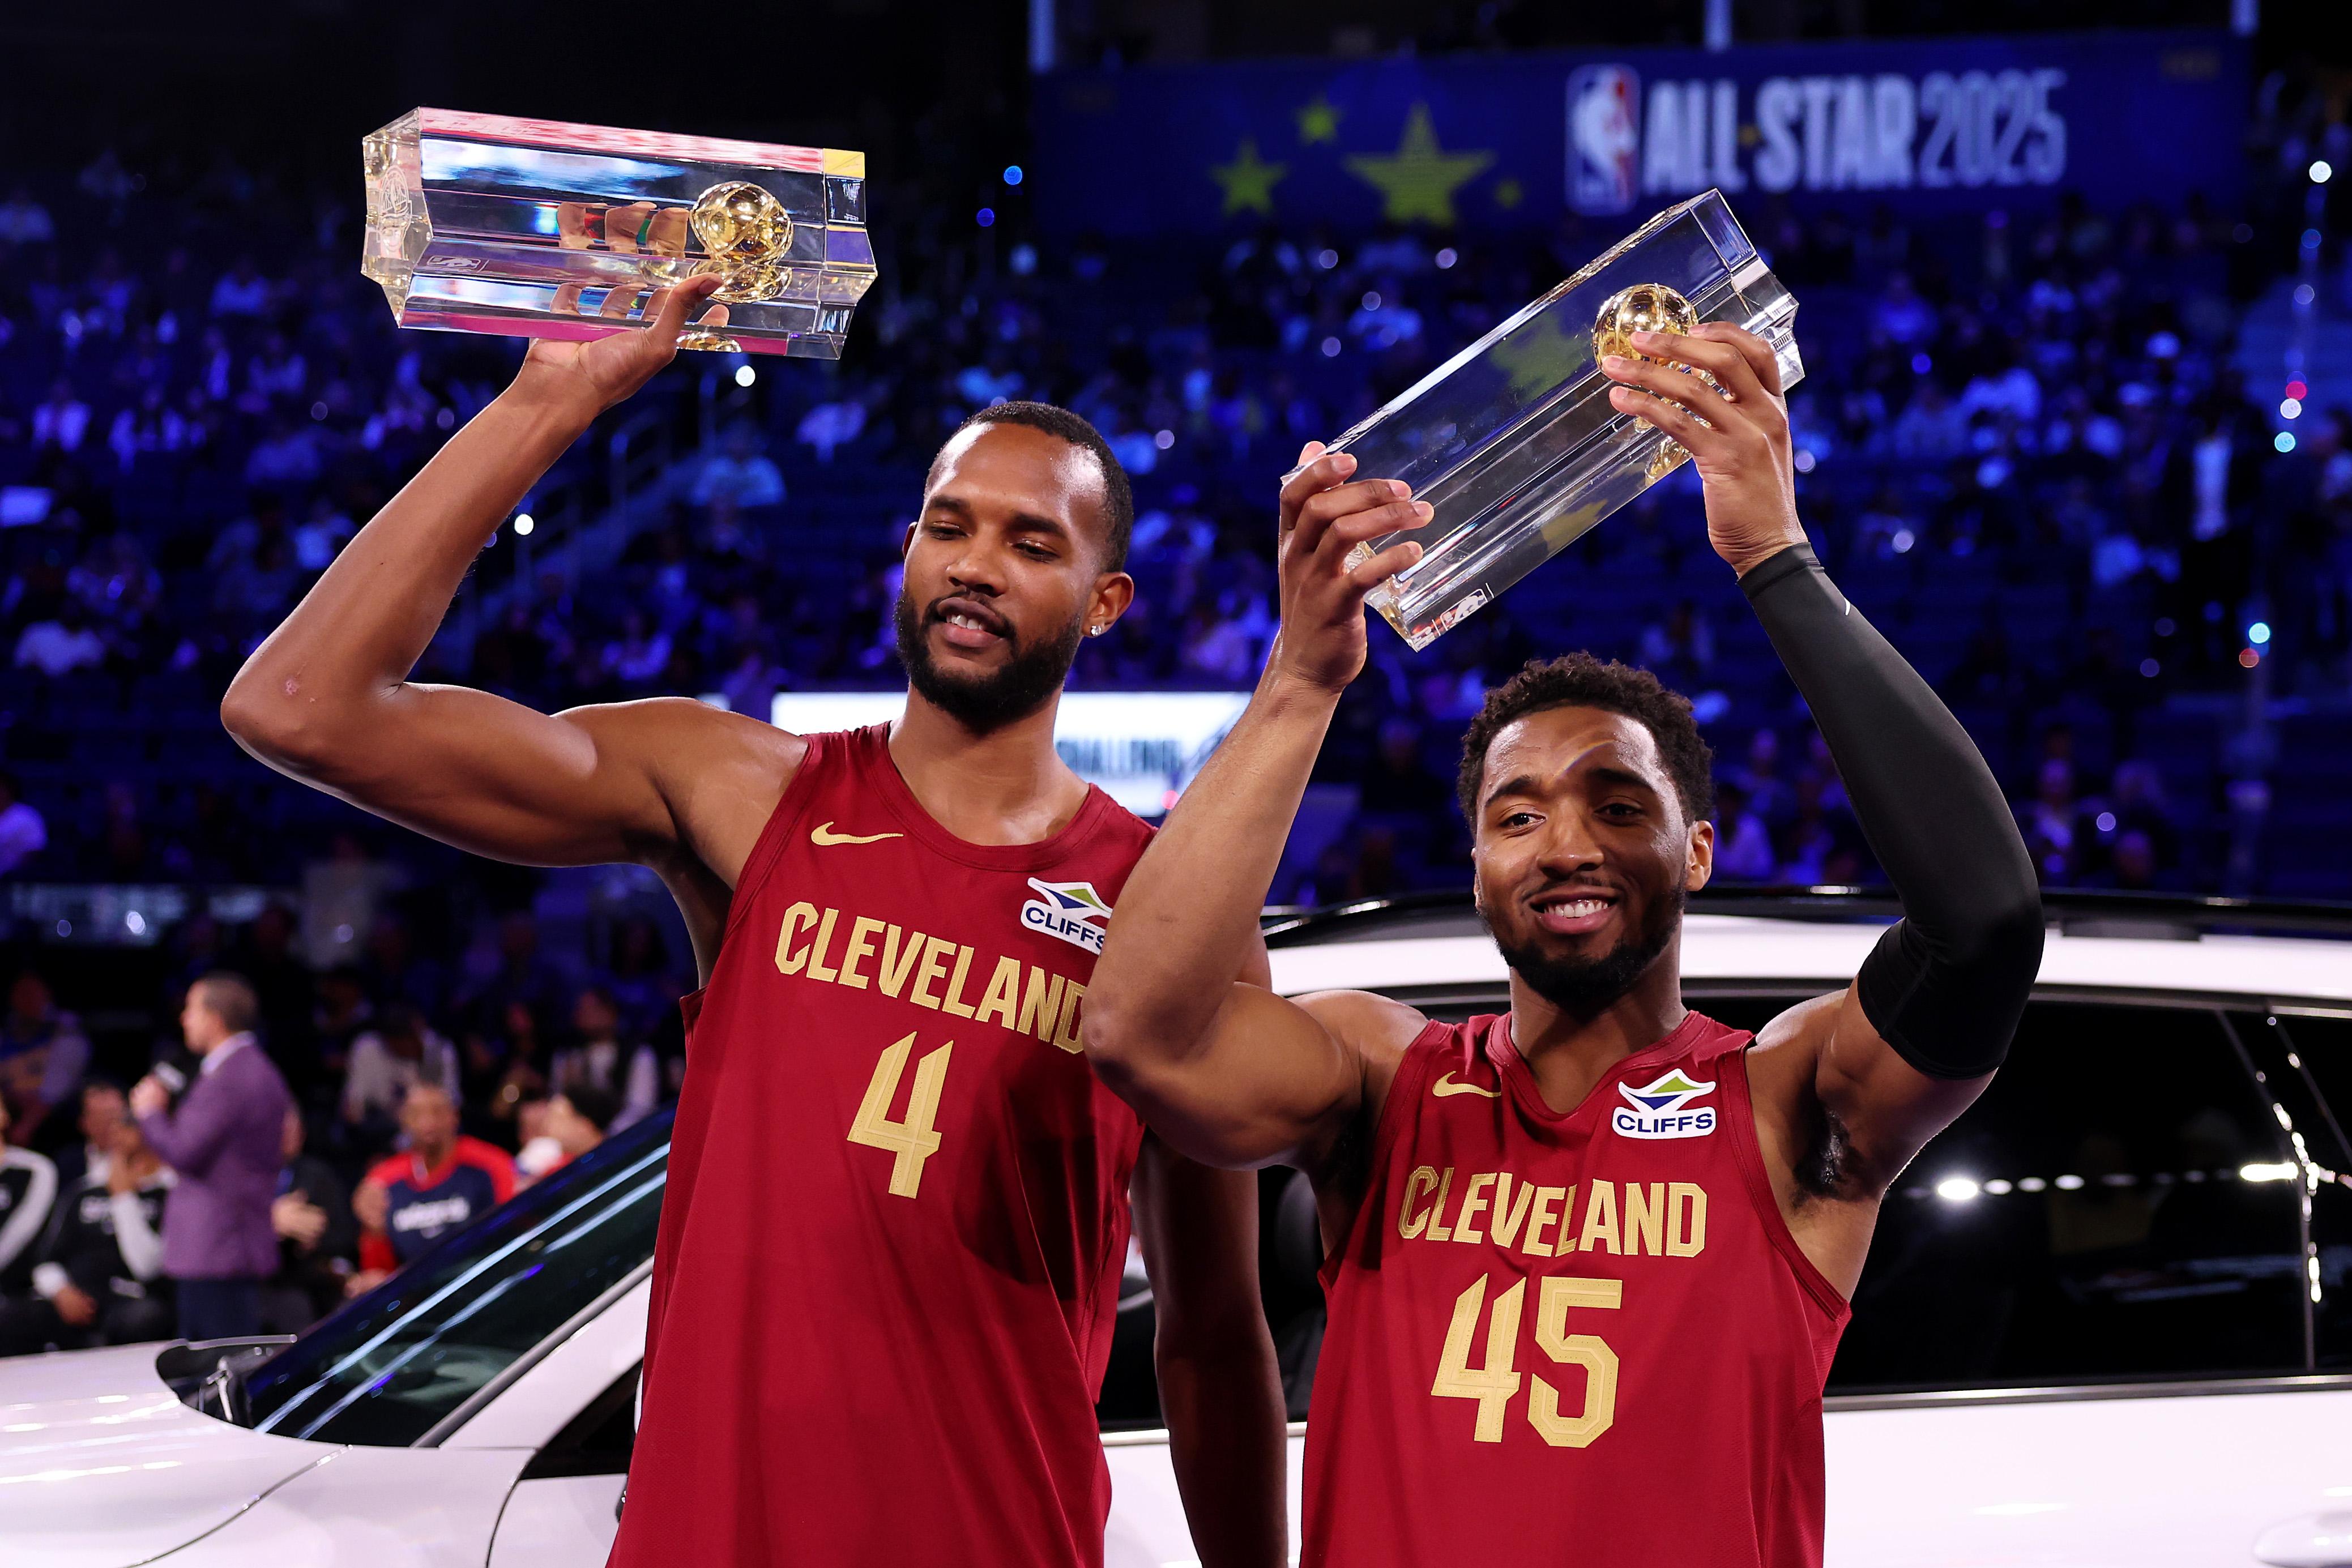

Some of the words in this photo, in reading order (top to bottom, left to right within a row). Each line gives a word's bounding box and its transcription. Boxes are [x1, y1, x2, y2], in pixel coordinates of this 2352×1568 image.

[1919, 69, 2067, 189] 2025
[775, 902, 1084, 1054] CLEVELAND
[847, 1031, 954, 1199] 4
[1617, 1112, 1713, 1133] CLIFFS
[1398, 1165, 1708, 1258] CLEVELAND
[1431, 1272, 1623, 1448] 45
